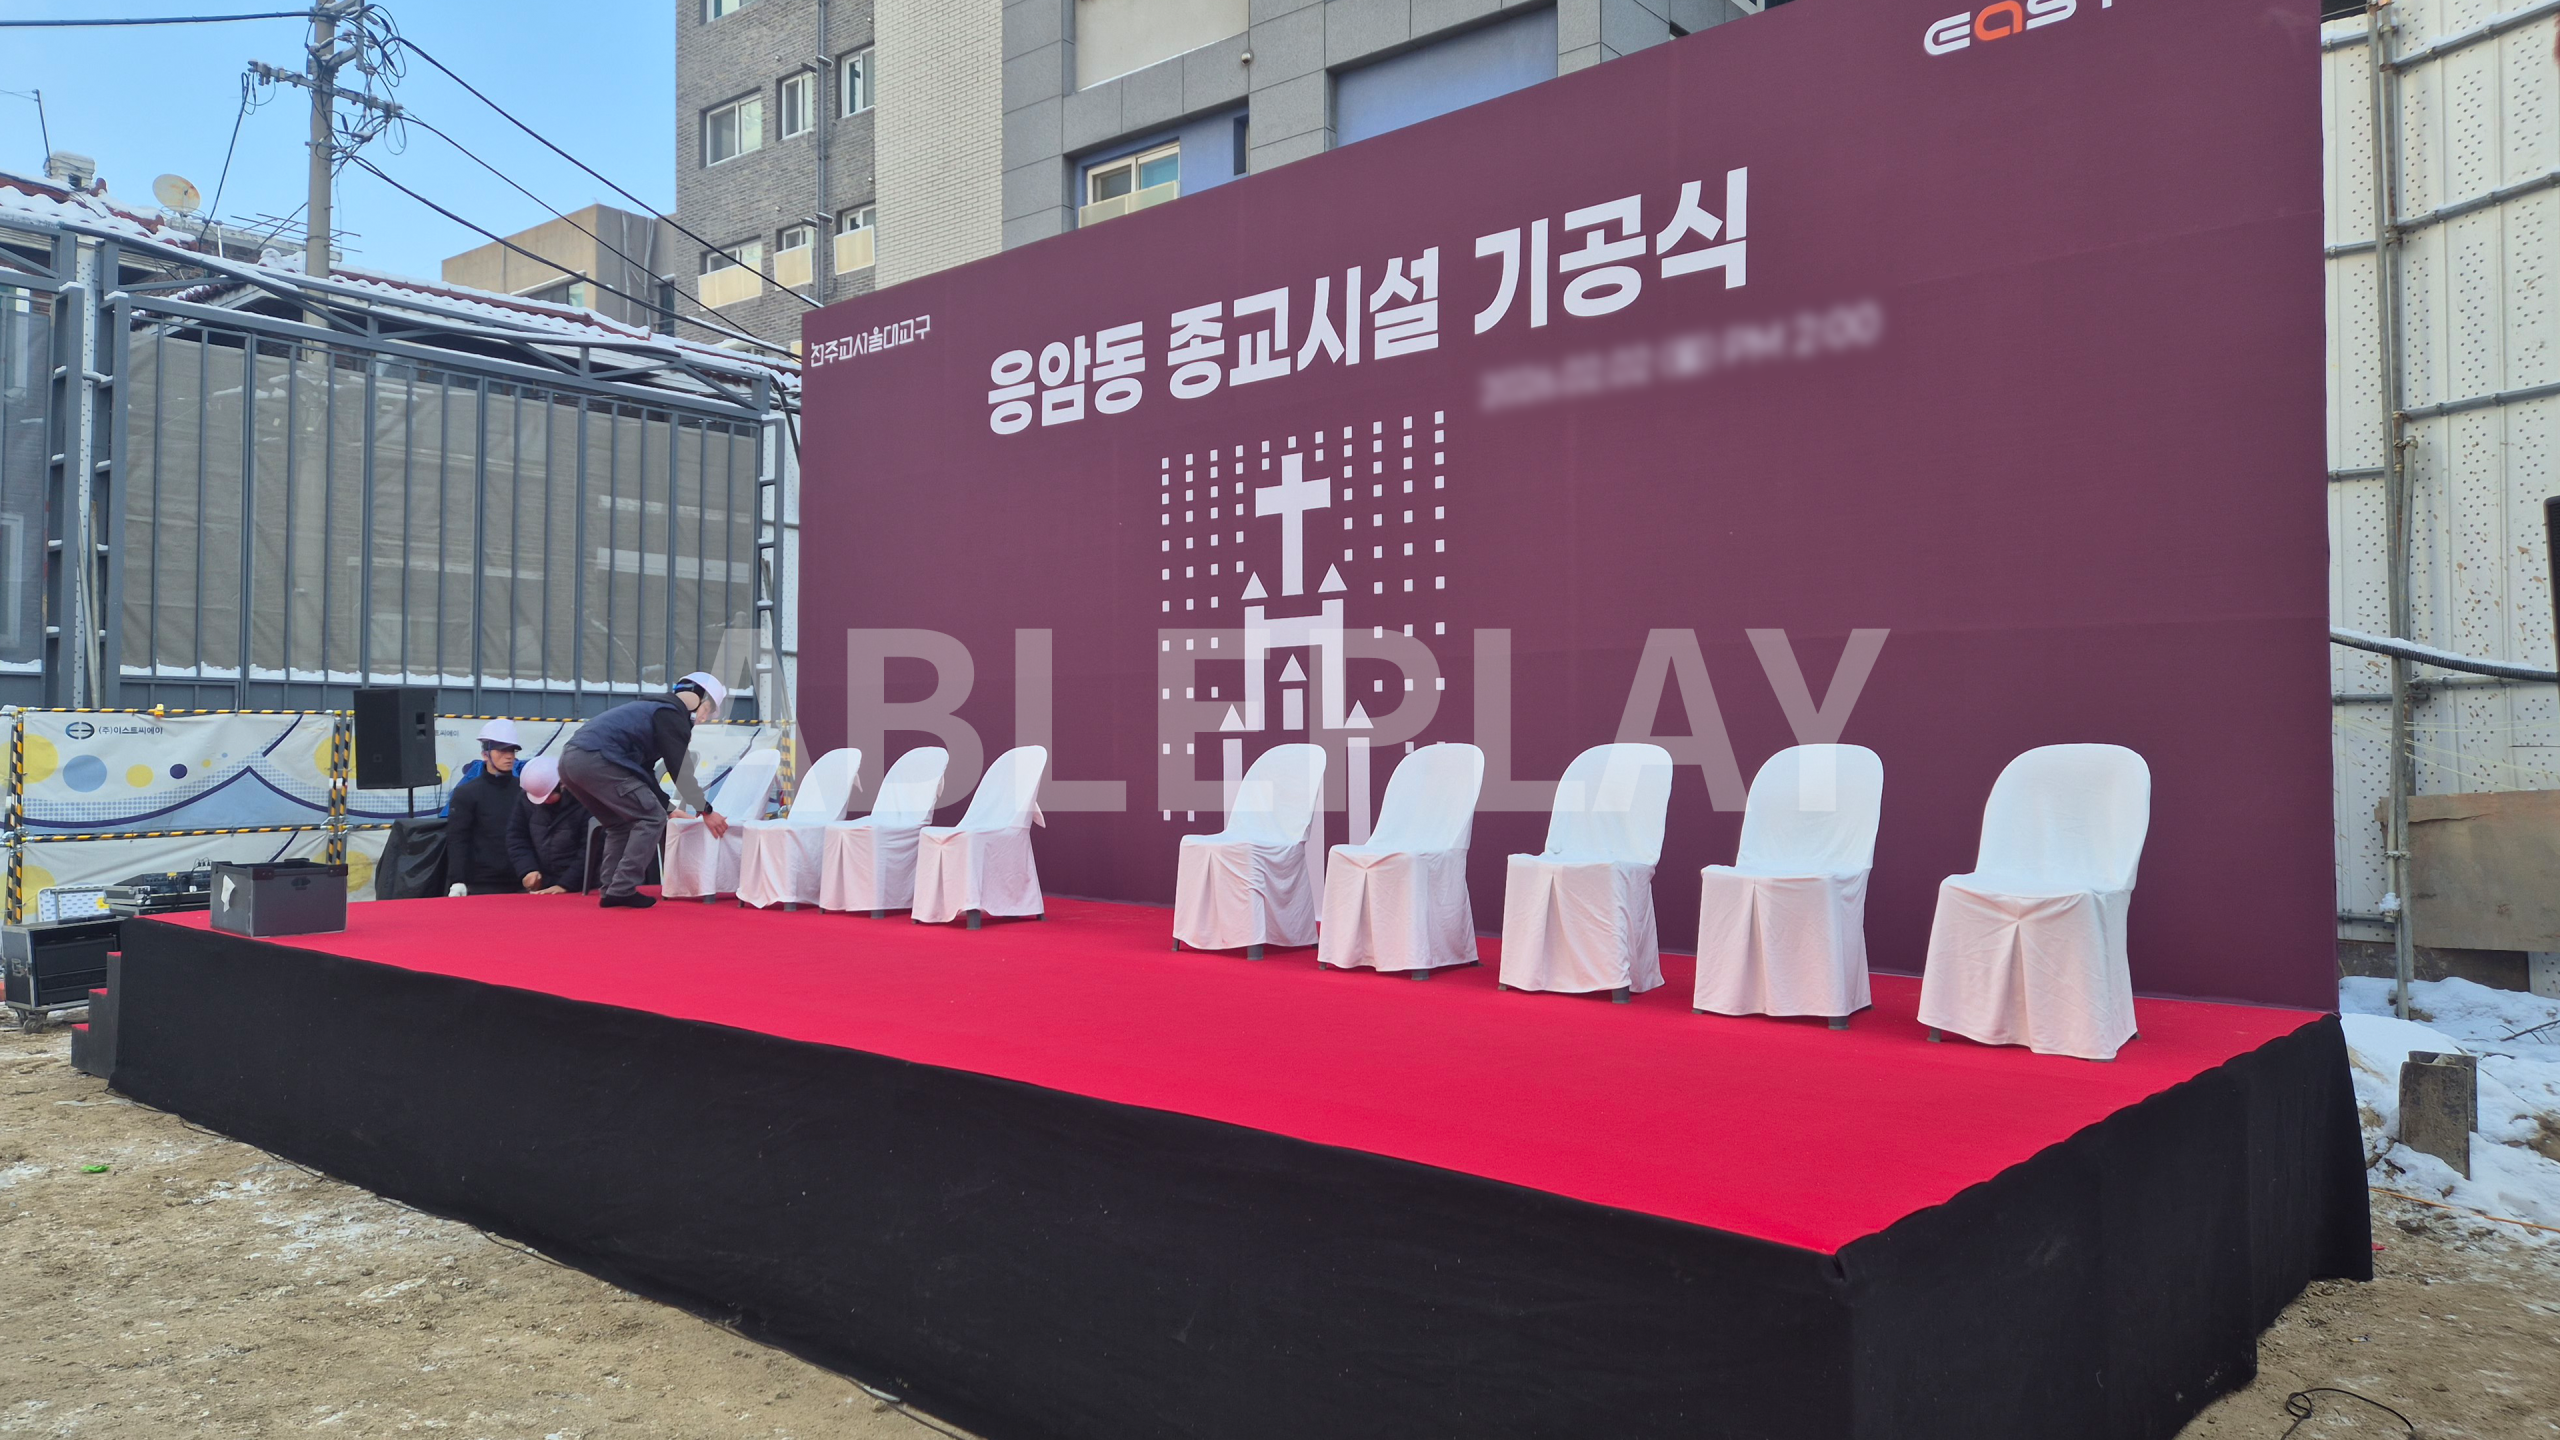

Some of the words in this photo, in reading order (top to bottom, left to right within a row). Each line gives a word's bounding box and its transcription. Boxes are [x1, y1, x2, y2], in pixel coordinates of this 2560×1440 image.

[988, 321, 1145, 434] 응암동
[1168, 247, 1438, 399] 종교시설
[1475, 167, 1747, 334] 기공식
[811, 314, 931, 368] 천주교서울대교구
[98, 726, 163, 735] (주)이스트씨에이
